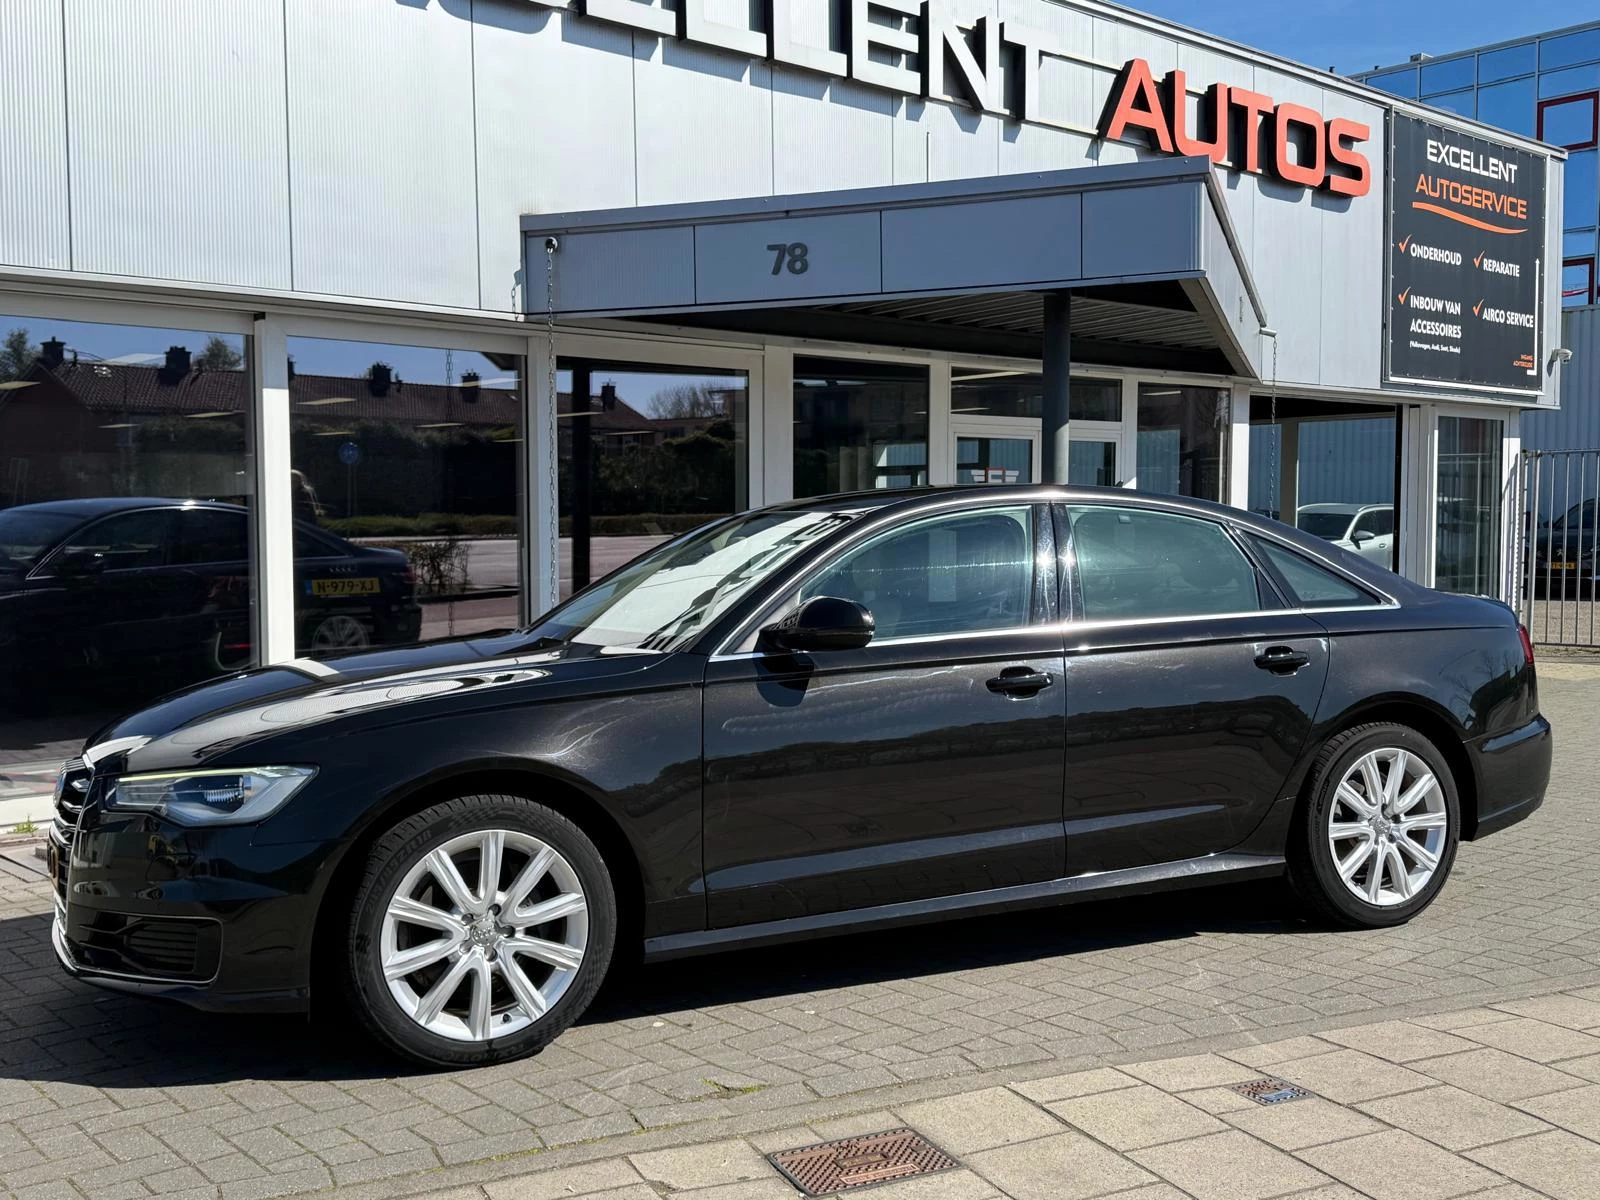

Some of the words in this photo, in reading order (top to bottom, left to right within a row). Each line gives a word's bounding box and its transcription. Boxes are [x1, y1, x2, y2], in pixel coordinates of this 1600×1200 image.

[1106, 58, 1371, 197] AUTOS
[1427, 139, 1517, 183] EXCELLENT
[1415, 173, 1528, 220] AUTOSERVICE
[767, 242, 809, 276] 78
[1410, 243, 1462, 266] ONDERHOUD
[1483, 258, 1520, 278] REPARATIE
[1410, 294, 1444, 312] INBOUW
[1445, 301, 1461, 316] VAN
[1410, 318, 1462, 339] ACCESSOIRES
[1482, 307, 1505, 324] AIRCO
[1506, 311, 1534, 328] SERVICE
